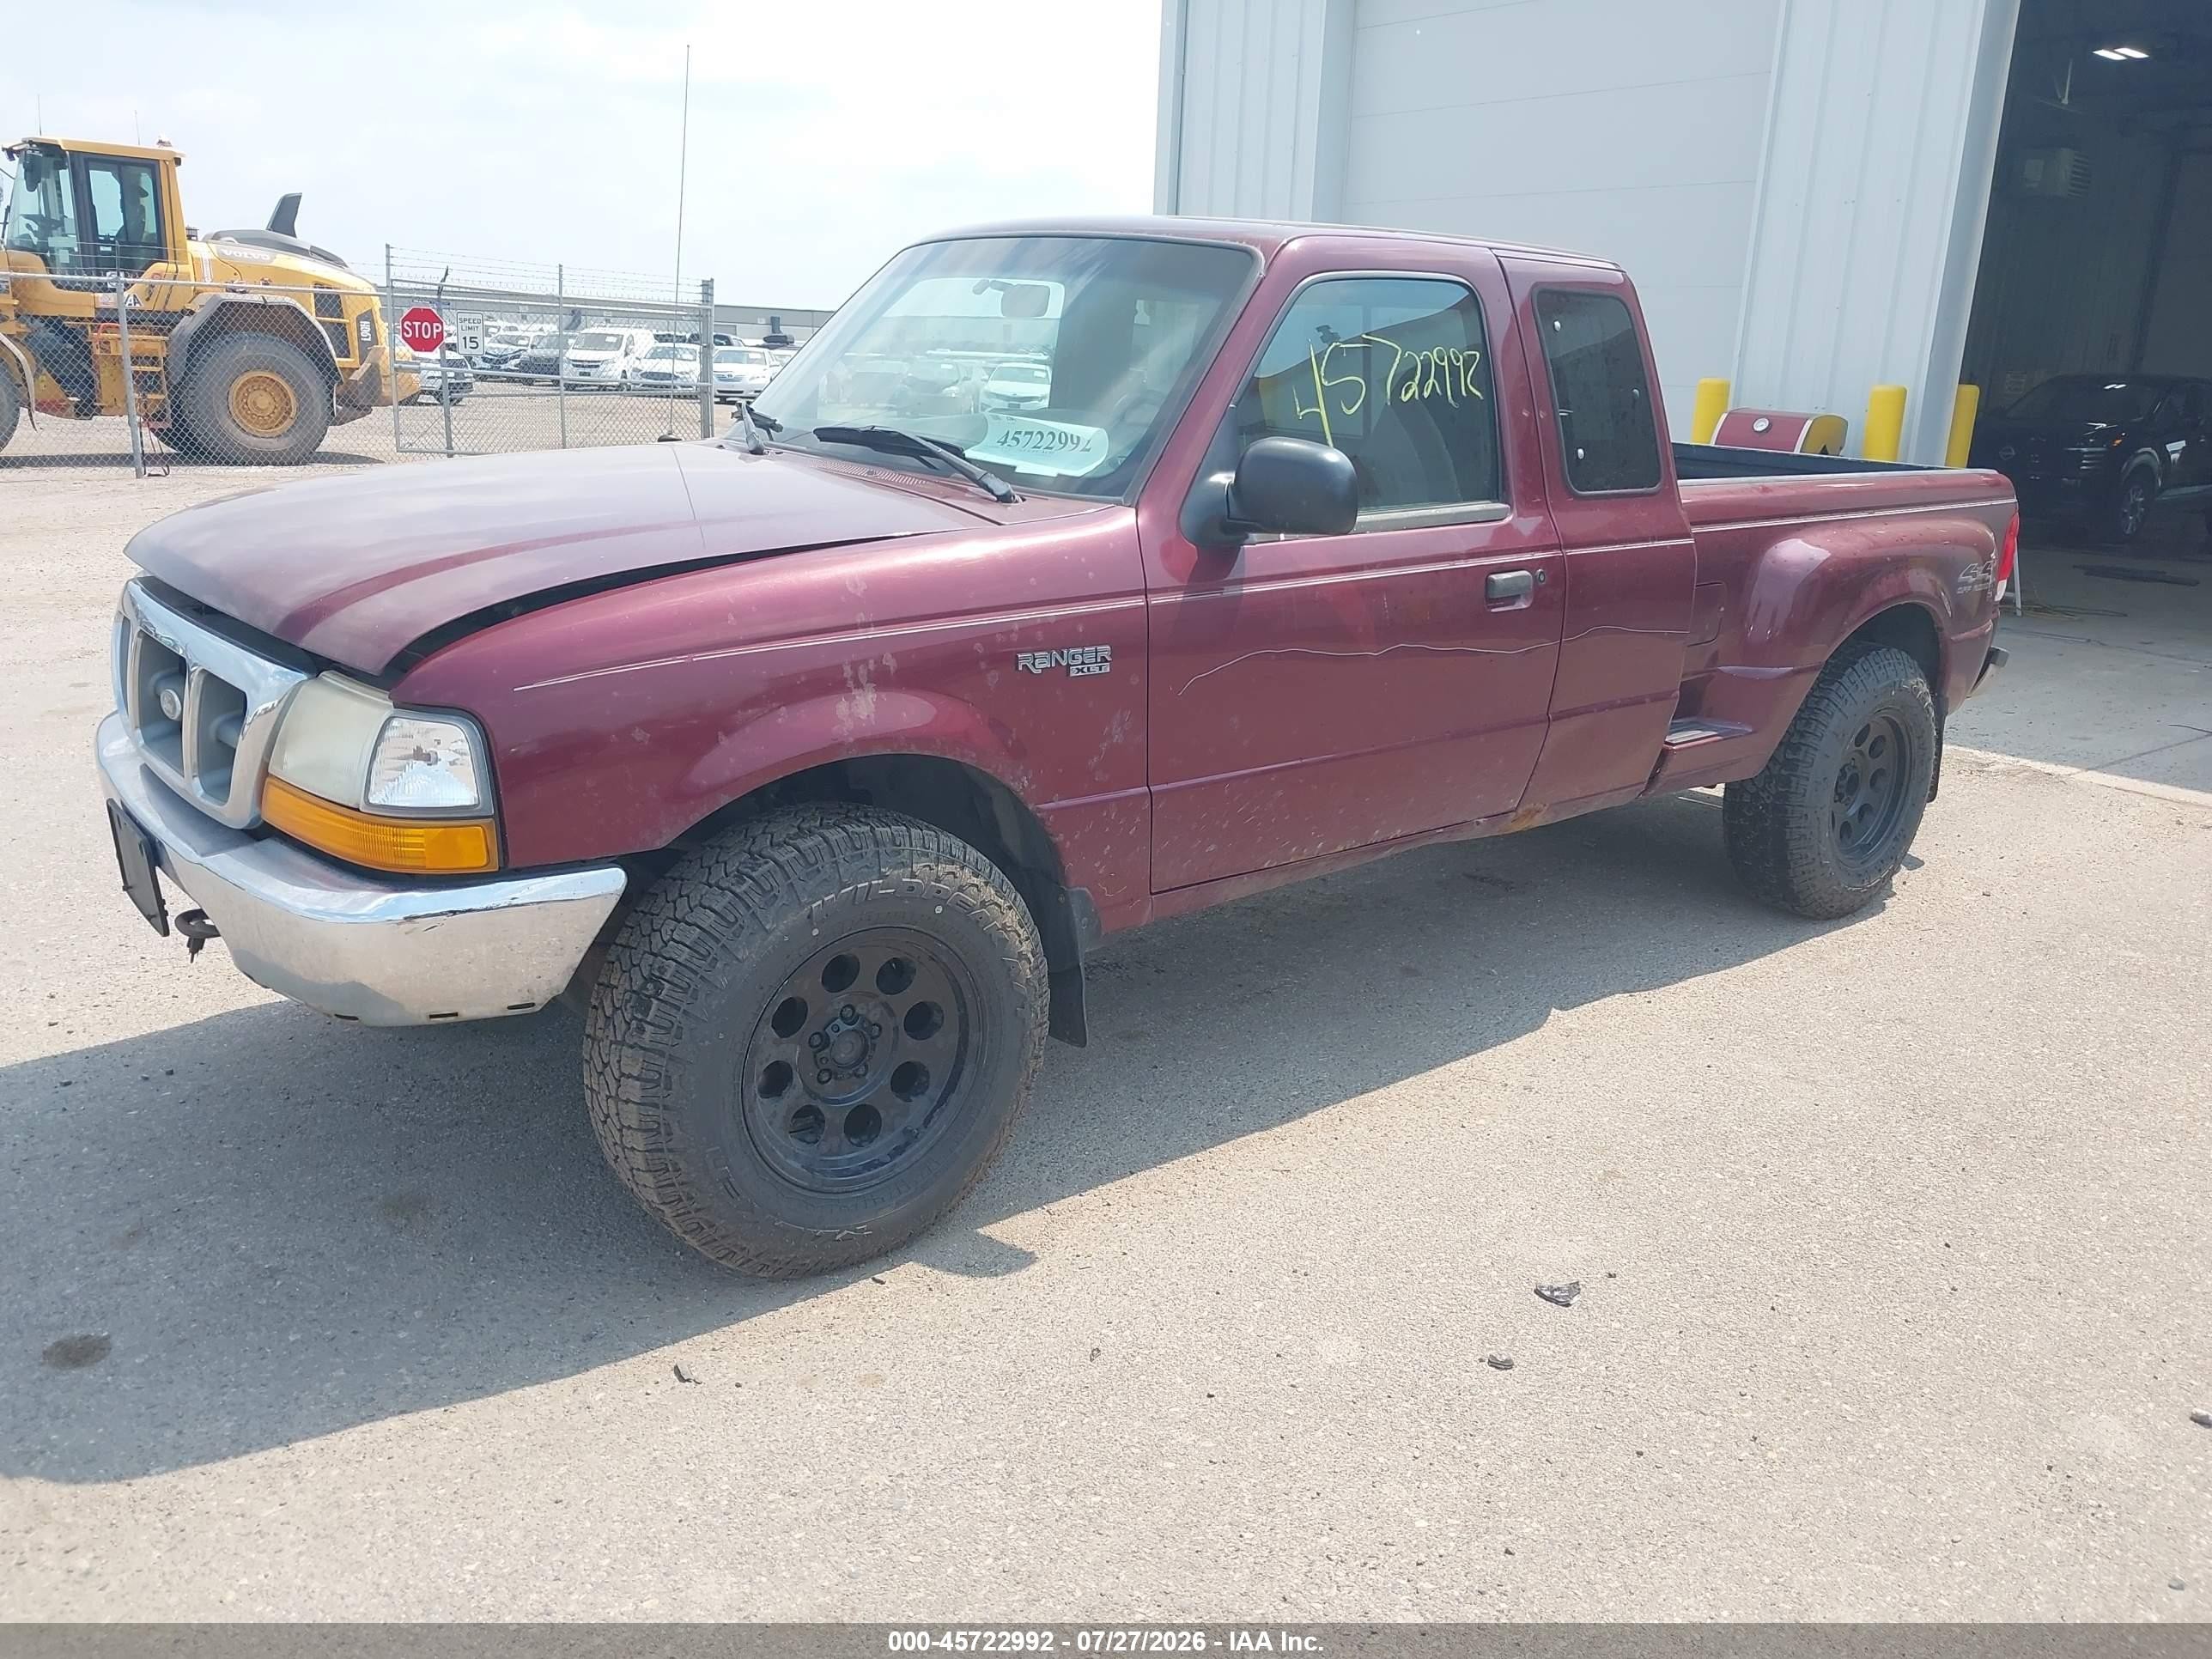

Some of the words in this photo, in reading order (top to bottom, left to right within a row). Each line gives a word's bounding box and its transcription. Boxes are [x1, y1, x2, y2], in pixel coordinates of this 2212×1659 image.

[403, 321, 442, 339] STOP
[462, 336, 480, 349] 15
[1292, 333, 1484, 448] 45722992
[1071, 664, 1109, 676] XLT
